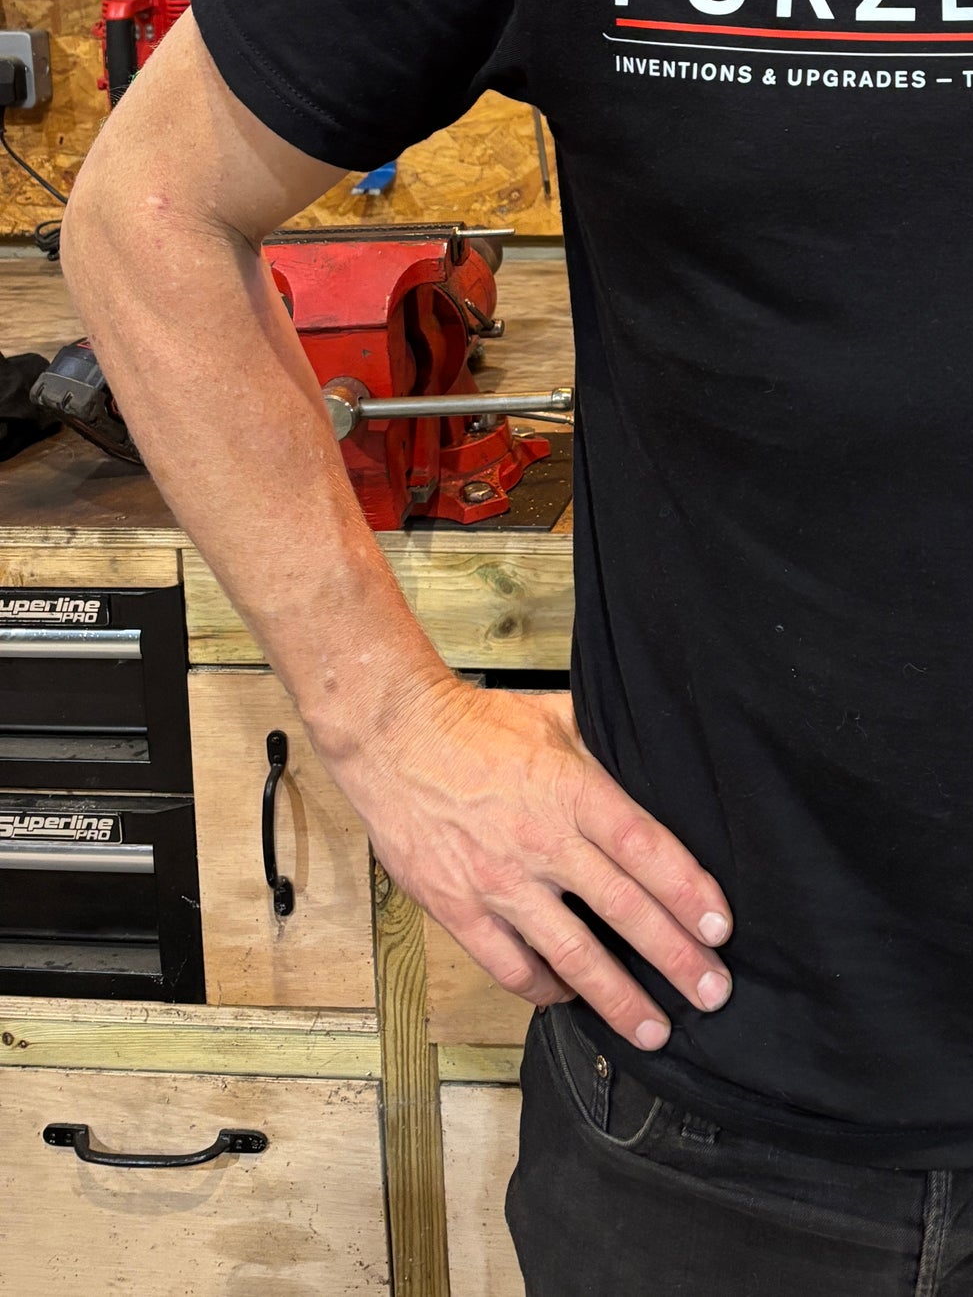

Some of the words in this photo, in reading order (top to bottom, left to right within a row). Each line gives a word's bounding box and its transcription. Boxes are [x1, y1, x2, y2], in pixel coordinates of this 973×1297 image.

[615, 54, 753, 84] INVENTIONS
[762, 69, 777, 86] &
[787, 68, 927, 88] UPGRADES
[0, 597, 101, 615] uperline
[61, 613, 98, 623] PRO
[0, 815, 114, 837] Superline
[75, 829, 111, 841] PRO
